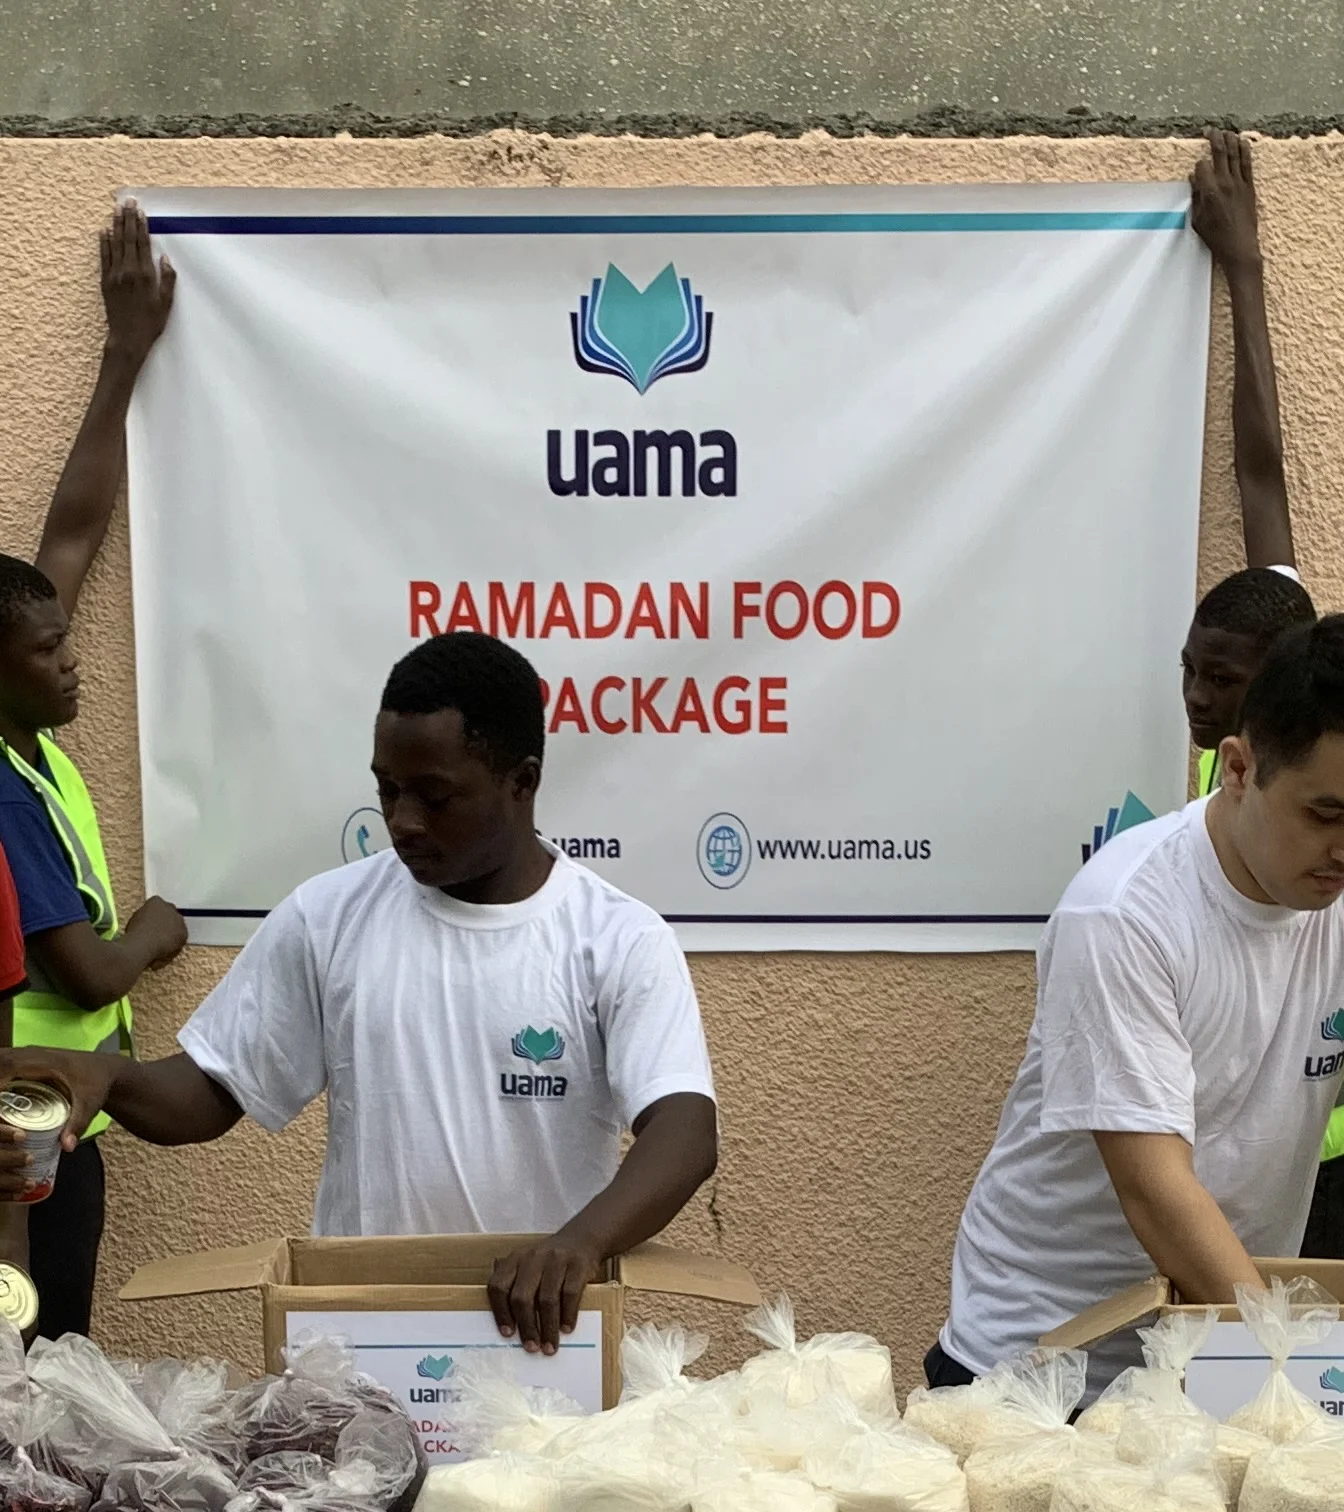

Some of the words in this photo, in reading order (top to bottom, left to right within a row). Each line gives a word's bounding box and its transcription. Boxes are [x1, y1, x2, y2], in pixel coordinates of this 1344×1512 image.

[547, 430, 737, 497] uama
[409, 580, 709, 641] RAMADAN
[734, 580, 900, 640] FOOD
[757, 840, 931, 860] www.uama.us
[501, 1073, 568, 1096] uama
